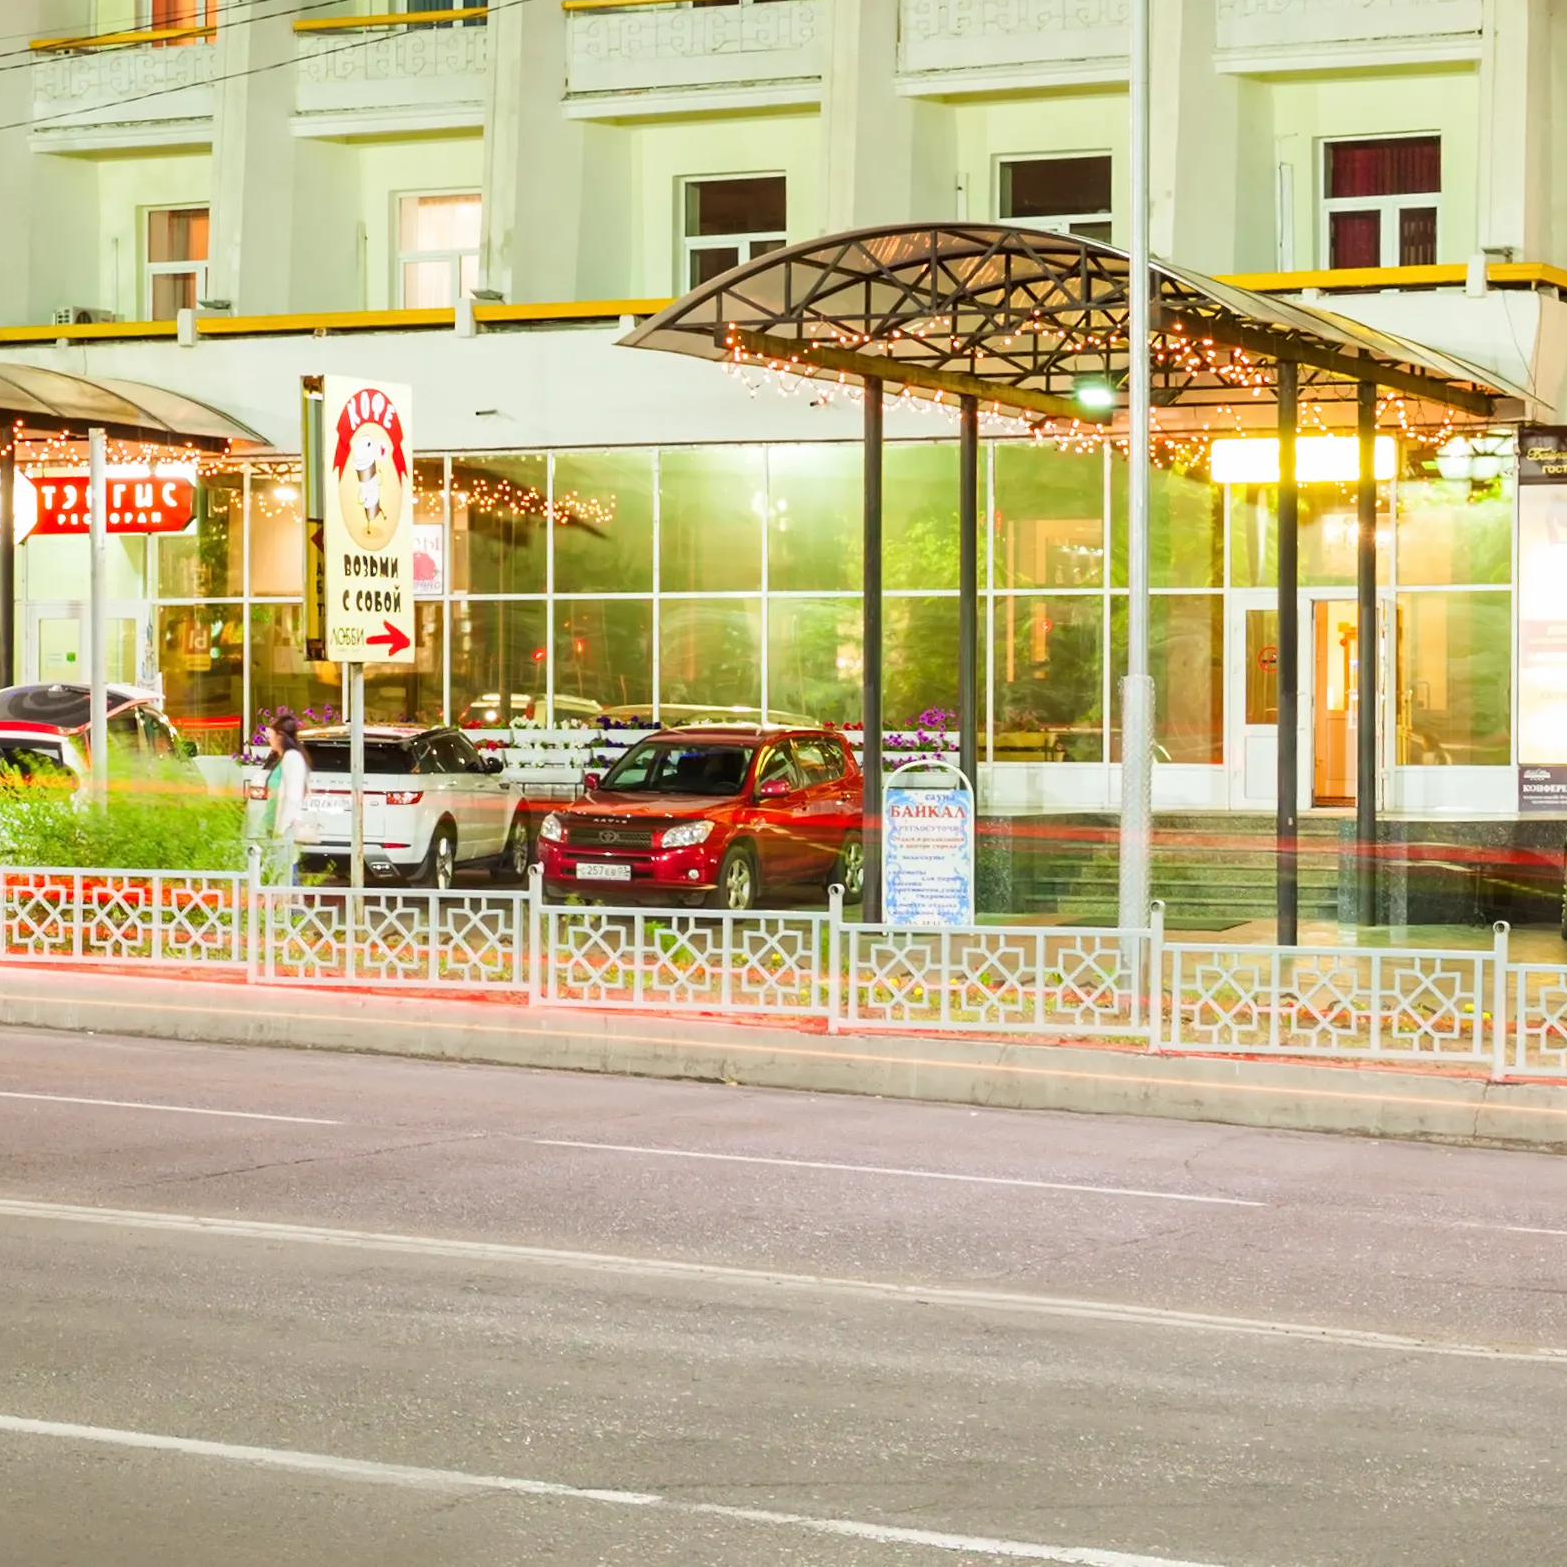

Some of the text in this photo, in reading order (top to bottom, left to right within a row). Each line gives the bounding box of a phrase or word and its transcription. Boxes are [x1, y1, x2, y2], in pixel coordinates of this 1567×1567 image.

[346, 391, 397, 431] КОФЕ
[57, 511, 162, 525] РЕСОРАН
[343, 553, 400, 578] ВОЗЬМИ
[342, 591, 350, 612] С
[356, 585, 402, 613] СОБОЙ
[330, 626, 365, 646] ЛОББИ
[890, 802, 967, 818] БАЙКАЛ
